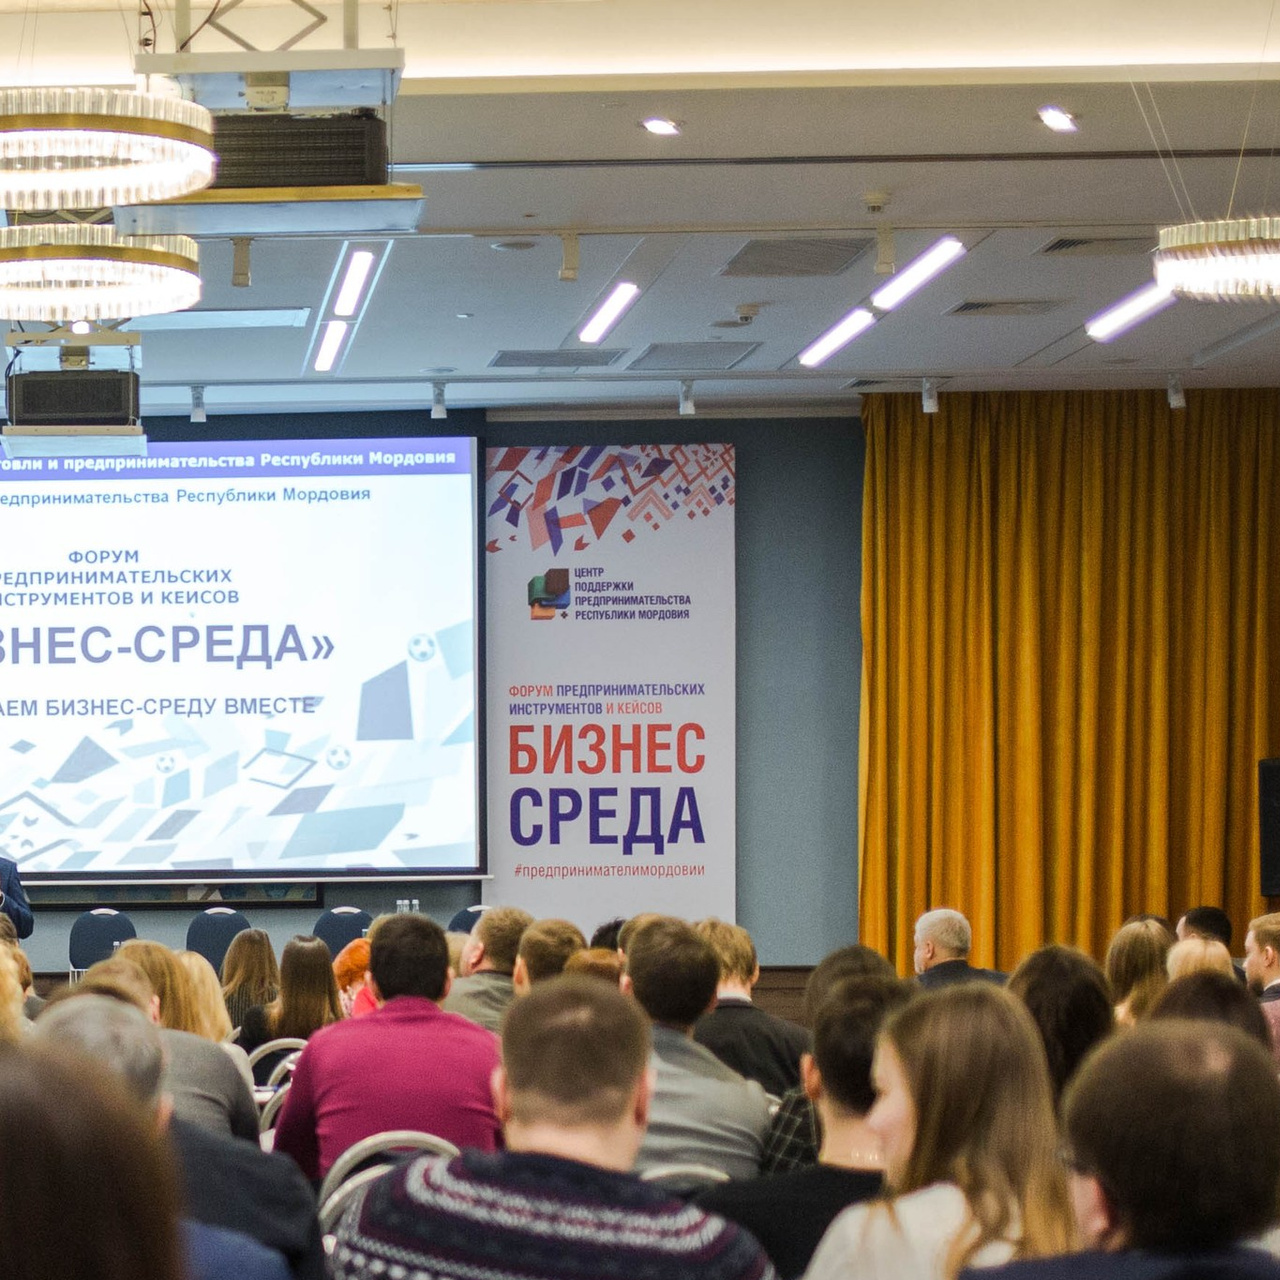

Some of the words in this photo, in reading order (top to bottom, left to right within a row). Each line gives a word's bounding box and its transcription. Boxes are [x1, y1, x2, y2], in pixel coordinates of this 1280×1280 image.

[47, 459, 58, 470] и
[64, 455, 255, 472] предпринимательства
[260, 452, 363, 469] Республики
[369, 451, 456, 467] Мордовия
[177, 488, 276, 505] Республики
[283, 487, 371, 503] Мордовия
[68, 550, 139, 564] ФОРУМ
[574, 567, 604, 578] ЦЕНТР
[574, 581, 634, 593] ПОДДЕРЖКИ
[141, 591, 154, 605] И
[575, 595, 691, 607] ПРЕДПРИНИМАТЕЛЬСТВА
[575, 610, 636, 620] РЕСПУБЛИКИ
[638, 609, 690, 620] МОРДОВИЯ
[509, 685, 553, 697] ФОРУМ
[556, 683, 705, 698] ПРЕДПРИНИМАТЕЛЬСКИХ
[46, 698, 217, 718] БИЗНЕС-СРЕДУ
[225, 696, 316, 715] ВМЕСТЕ
[509, 702, 603, 715] ИНСТРУМЕНТОВ
[606, 702, 614, 714] И
[617, 700, 663, 715] КЕЙСОВ
[509, 722, 706, 774] БИЗНЕС
[509, 786, 706, 856] СРЕДА
[514, 863, 706, 880] #предпринимателимордовии
